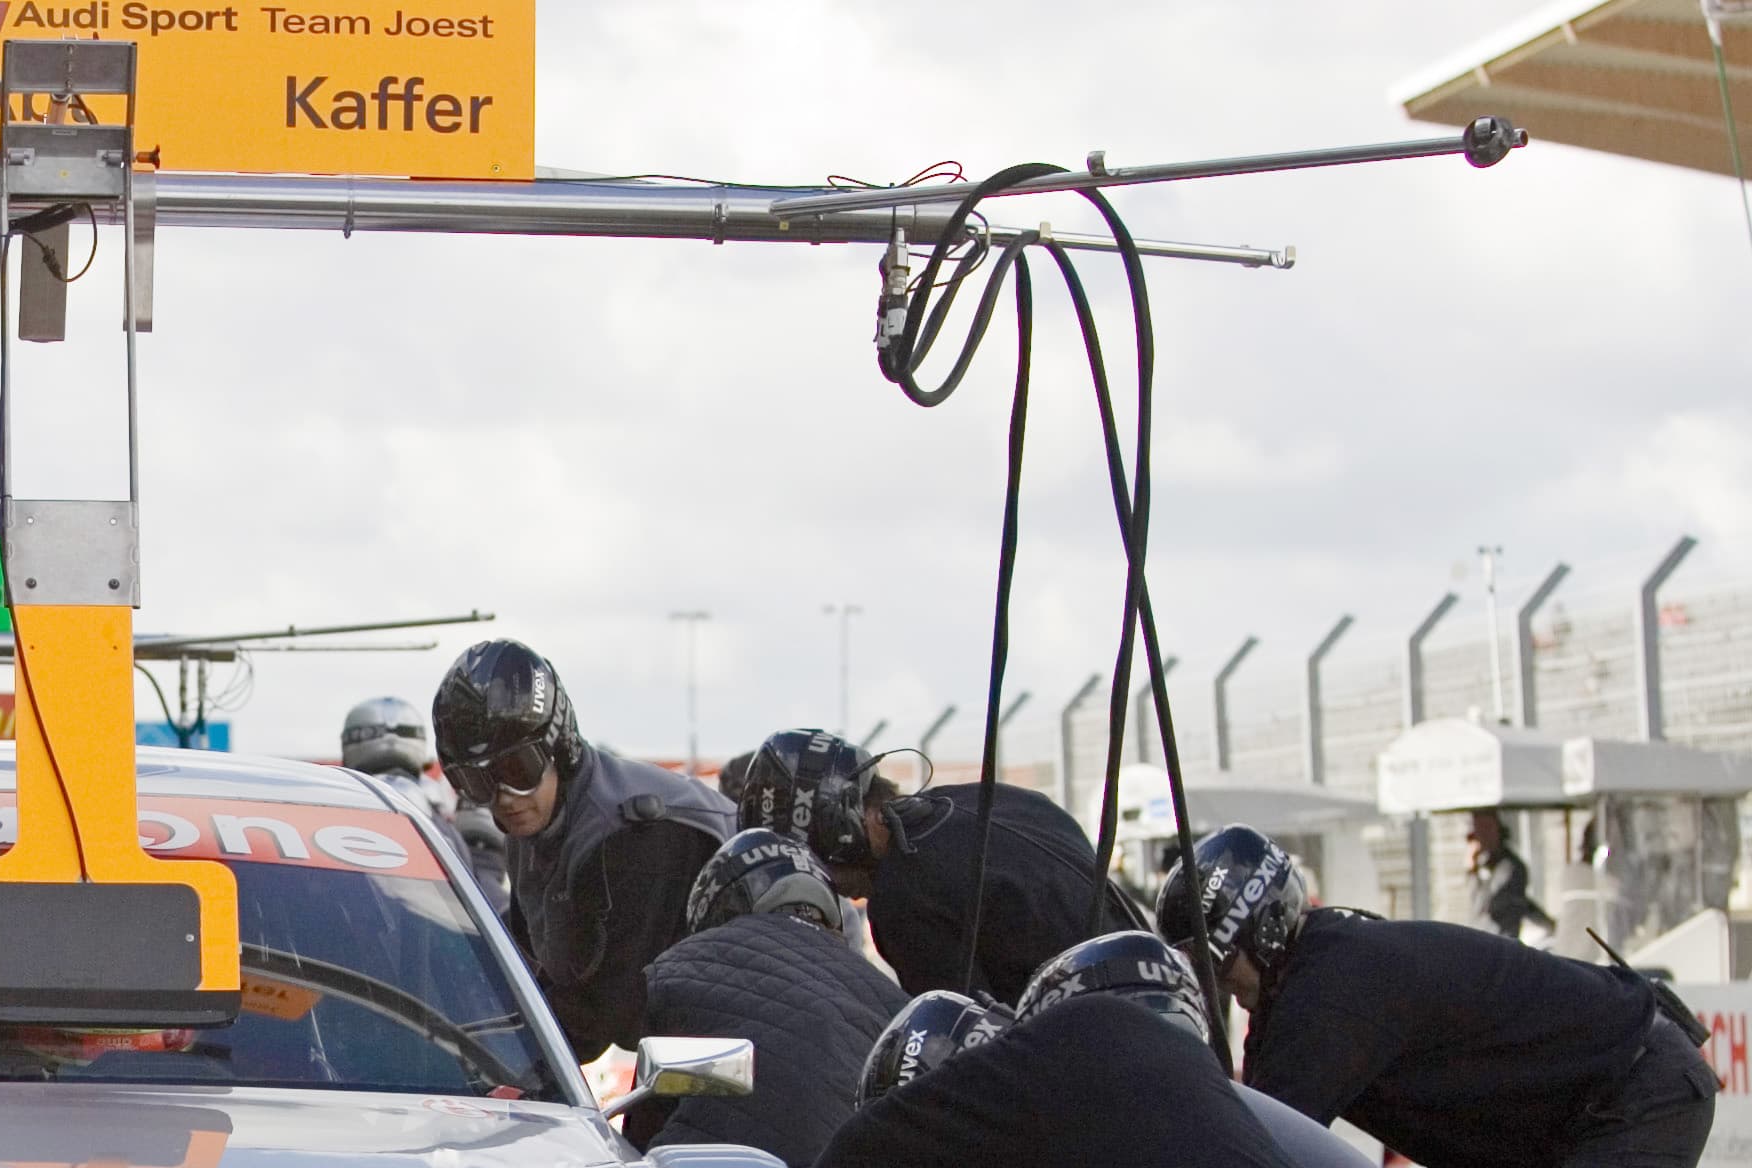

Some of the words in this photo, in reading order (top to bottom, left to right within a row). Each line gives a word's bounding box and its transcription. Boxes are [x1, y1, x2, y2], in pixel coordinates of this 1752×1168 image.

[13, 1, 109, 28] Audi
[121, 2, 239, 36] Sport
[260, 7, 371, 35] Team
[384, 10, 495, 39] Joest
[285, 75, 494, 134] Kaffer
[533, 669, 546, 714] uvex
